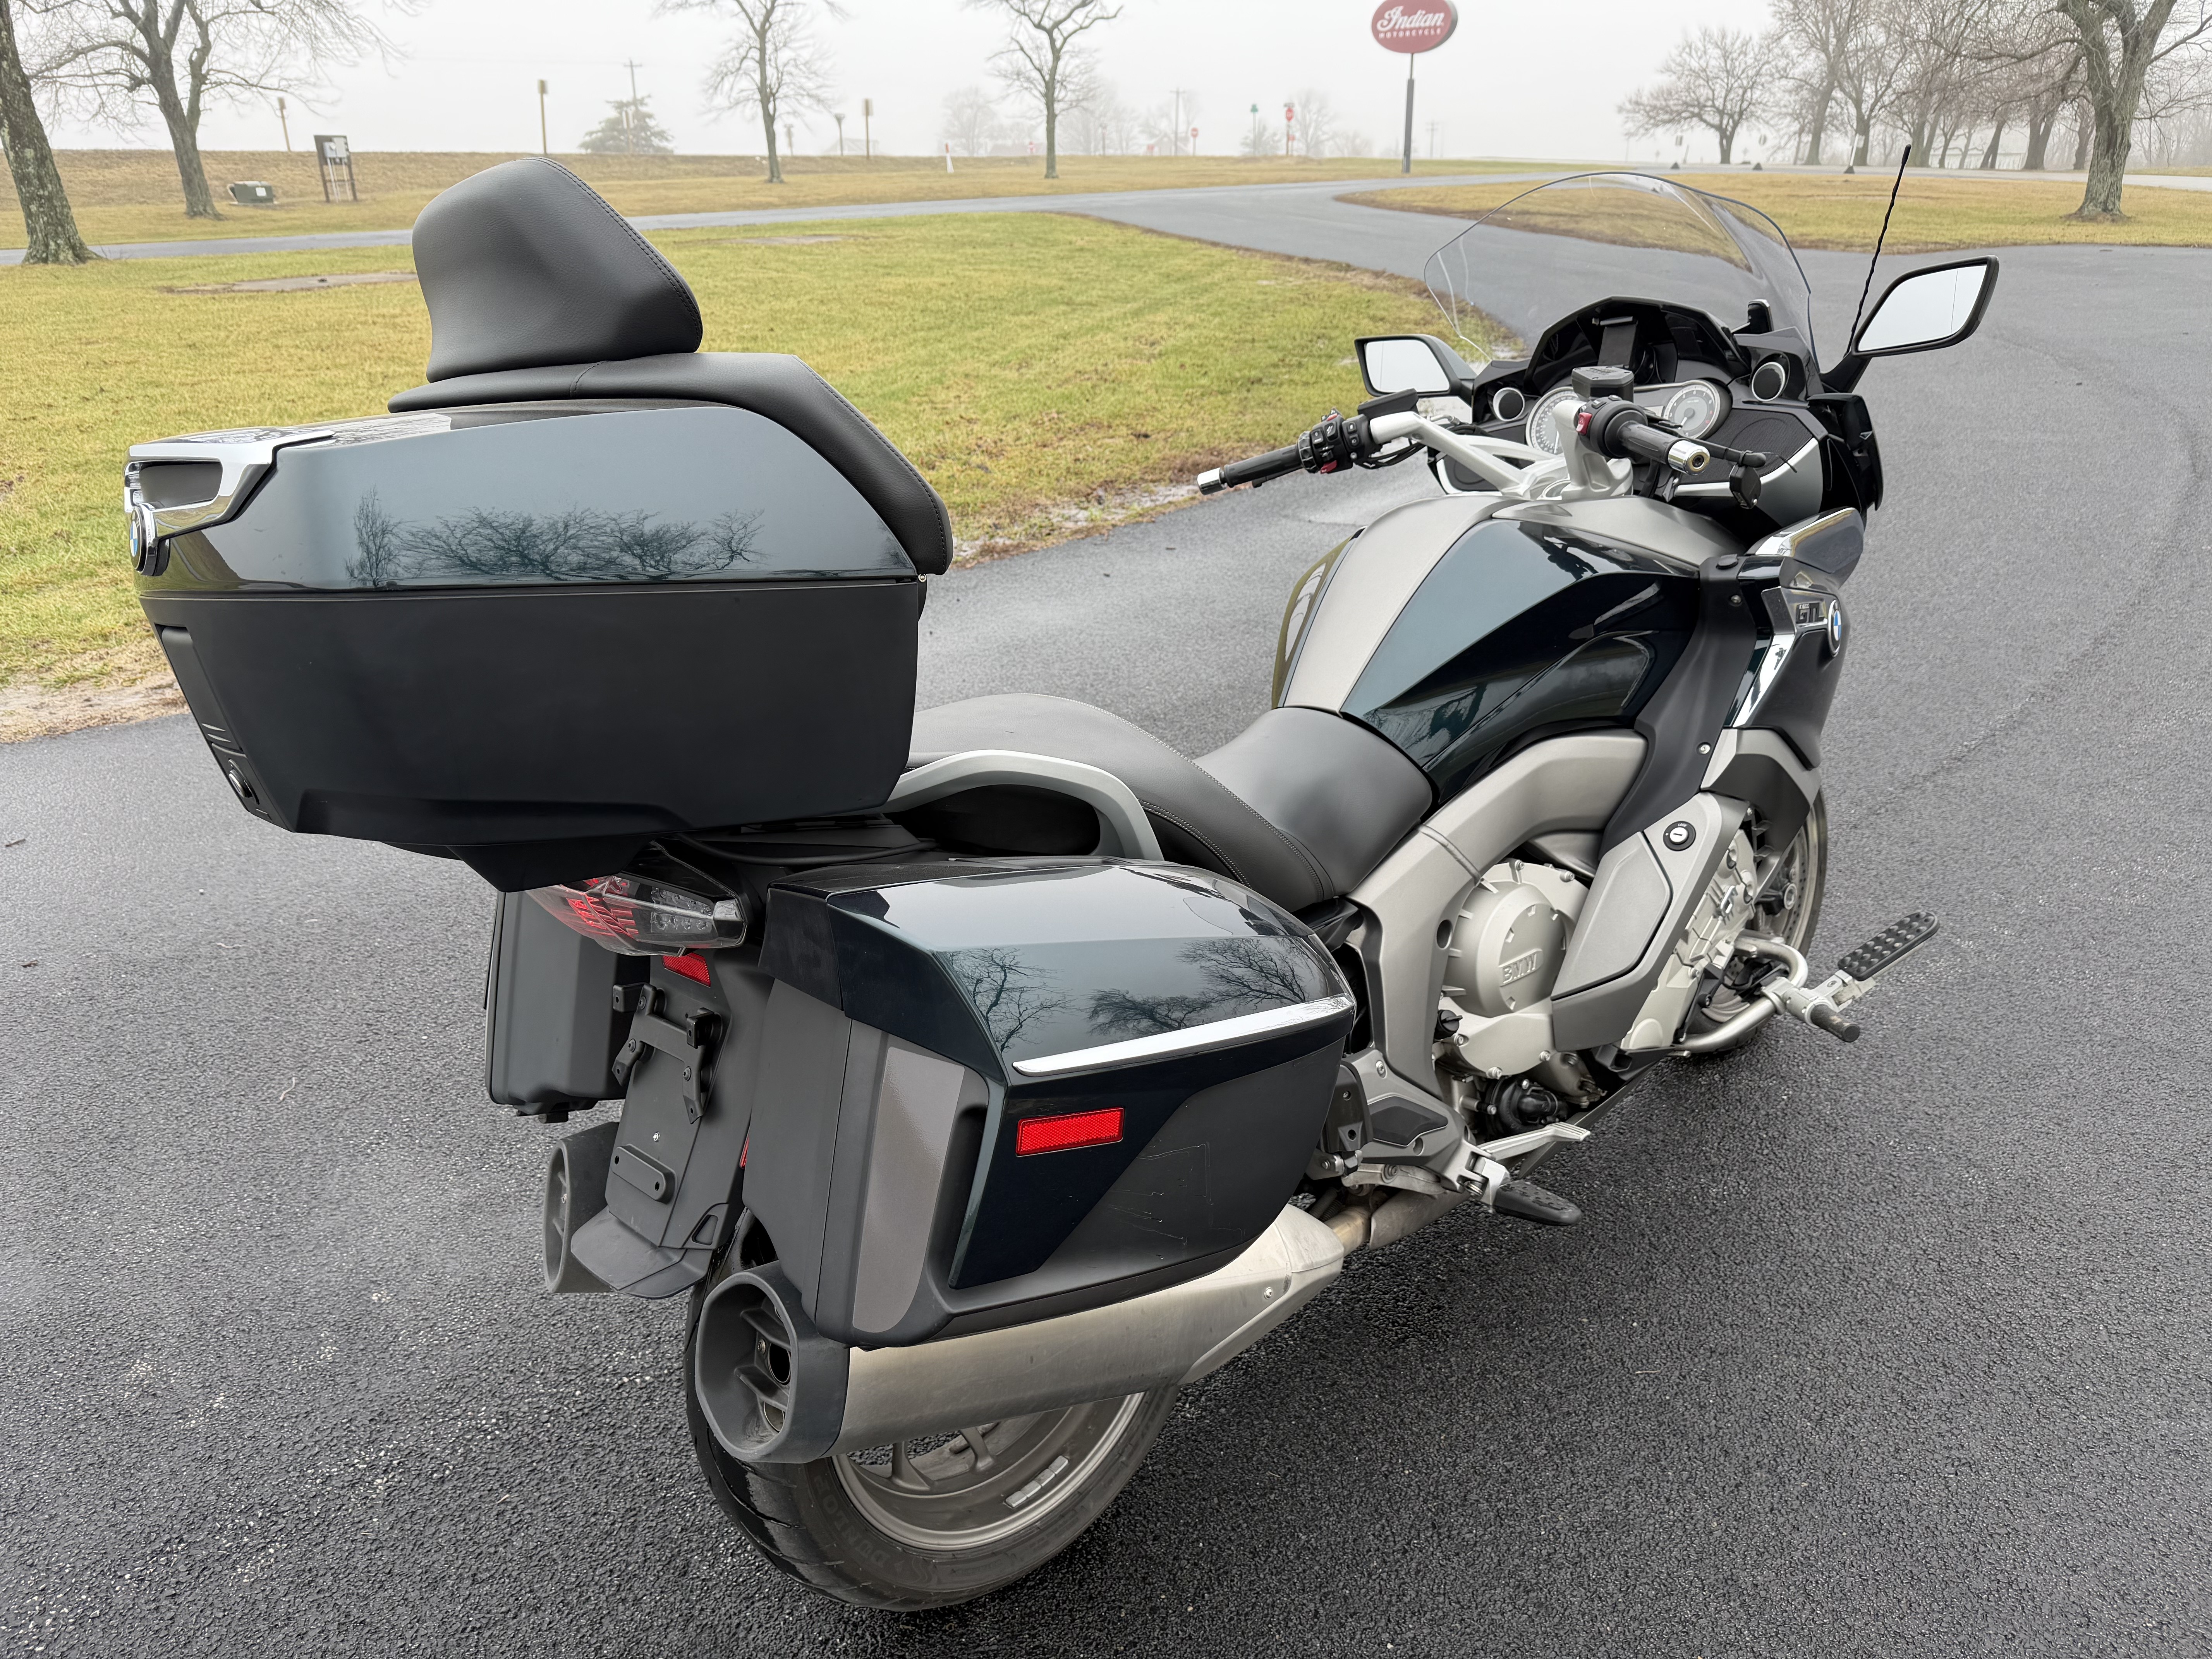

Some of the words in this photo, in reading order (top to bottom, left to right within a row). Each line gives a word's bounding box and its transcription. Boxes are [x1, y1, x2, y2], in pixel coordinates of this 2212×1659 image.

[1377, 6, 1444, 31] Indian
[1379, 27, 1441, 39] MOTORCYCLE
[1503, 952, 1537, 984] BMW
[813, 1474, 891, 1568] DUNLOP
